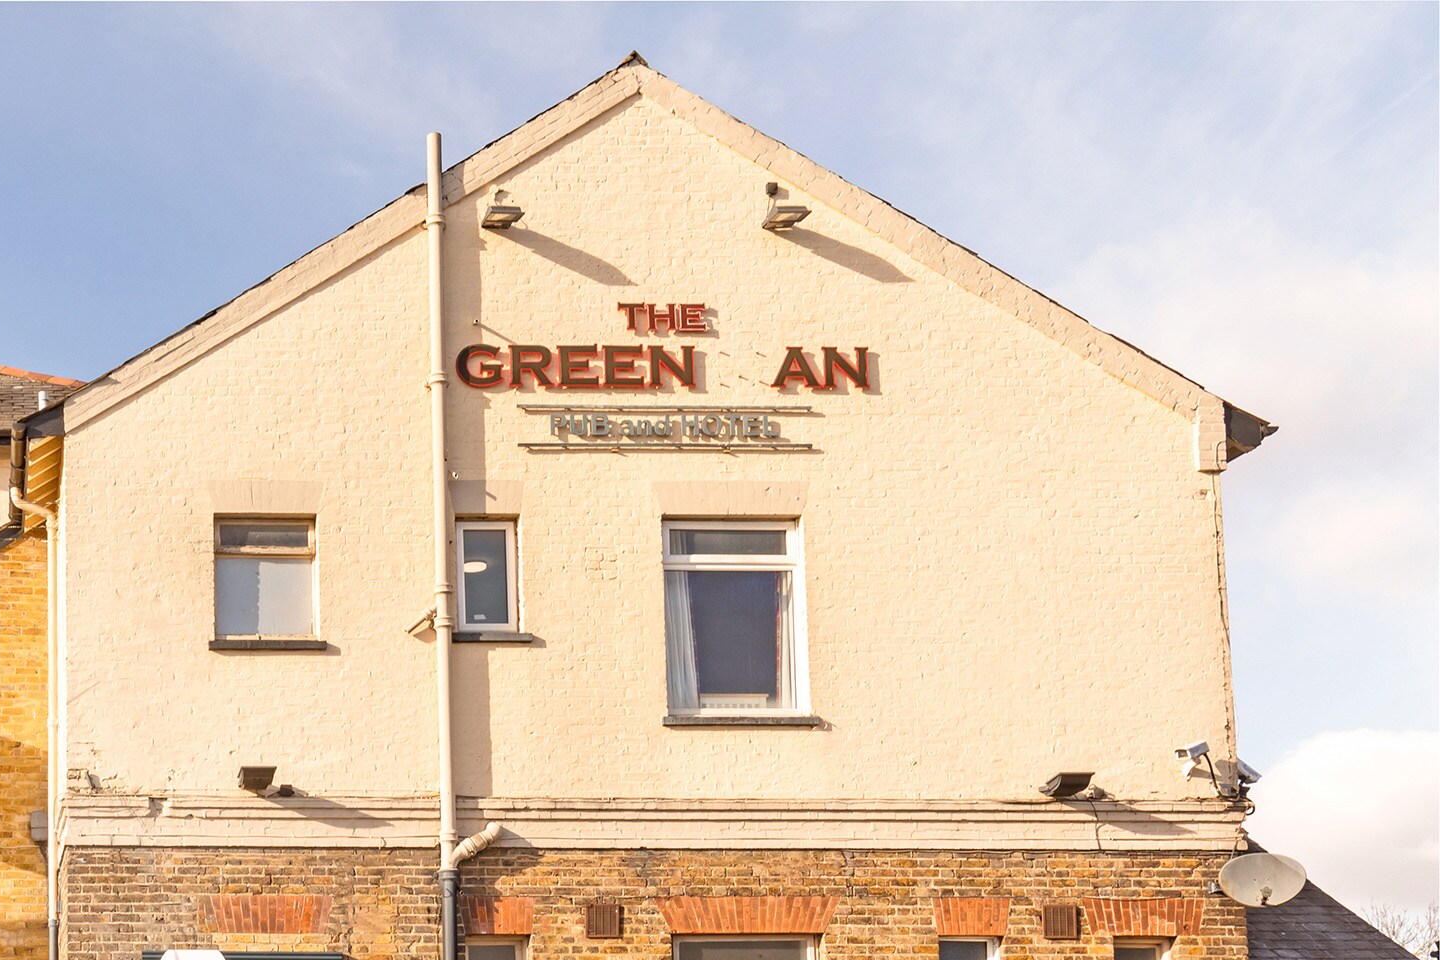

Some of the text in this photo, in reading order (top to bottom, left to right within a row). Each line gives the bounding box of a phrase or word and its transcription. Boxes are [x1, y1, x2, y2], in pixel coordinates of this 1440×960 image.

[617, 301, 707, 332] THE
[456, 343, 872, 389] GREEN AN
[549, 413, 782, 438] PUB and HOTEL
